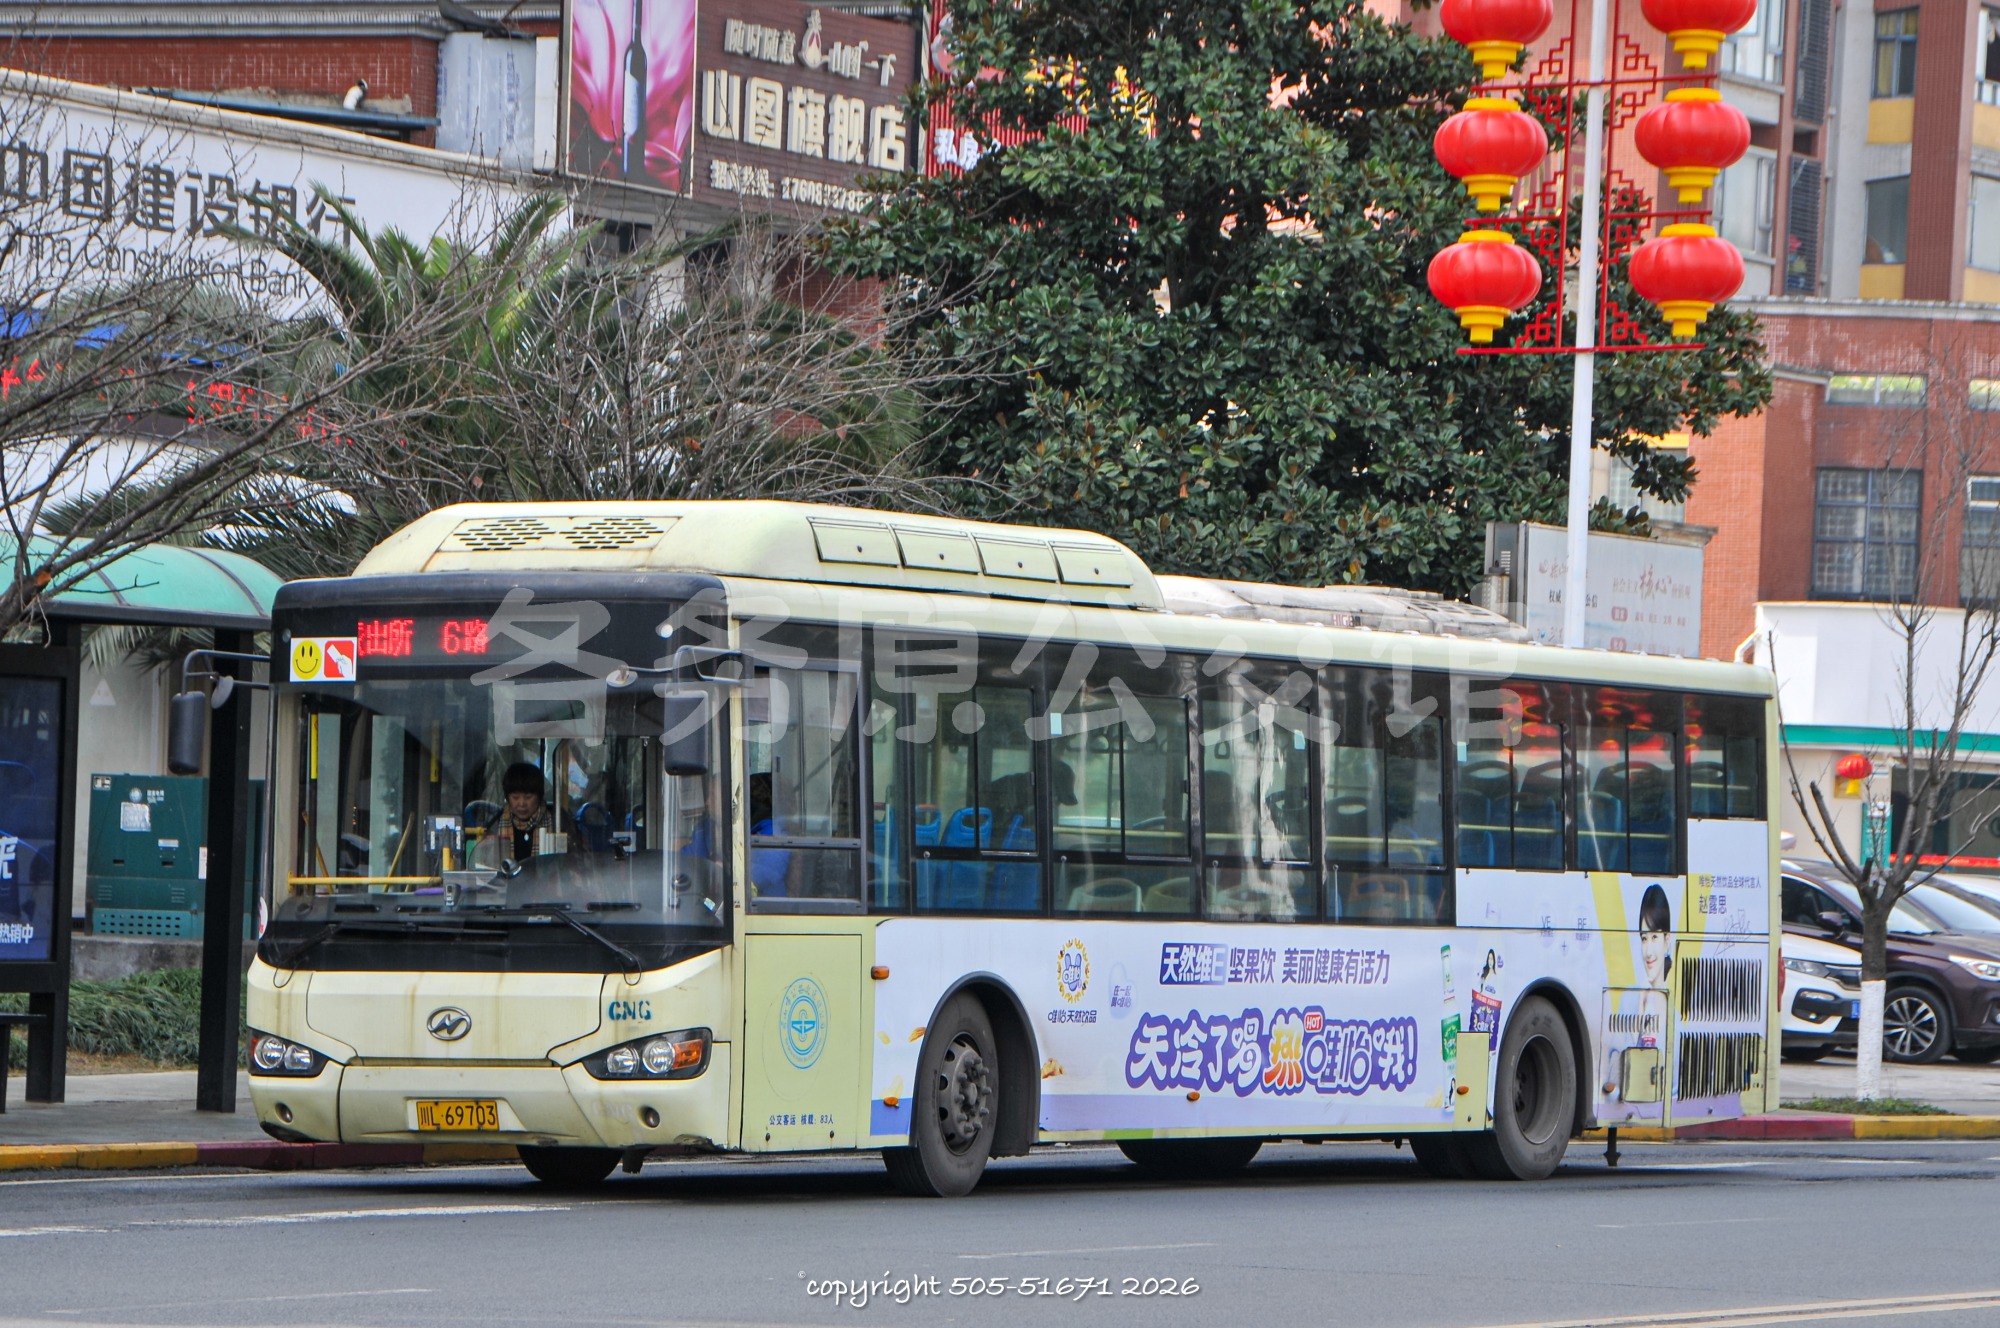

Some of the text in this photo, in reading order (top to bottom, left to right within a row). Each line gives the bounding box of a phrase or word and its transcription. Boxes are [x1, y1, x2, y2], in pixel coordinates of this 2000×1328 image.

[702, 69, 907, 171] 山图旗舰店
[0, 141, 356, 248] 中国建设银行
[250, 257, 310, 300] Bank
[442, 618, 490, 655] 6路
[1699, 895, 1727, 914] 赵露思
[1227, 947, 1277, 984] 坚果饮
[1281, 947, 1391, 985] 美丽健康有活力
[608, 1000, 652, 1021] CNG
[1306, 1015, 1321, 1029] HOT
